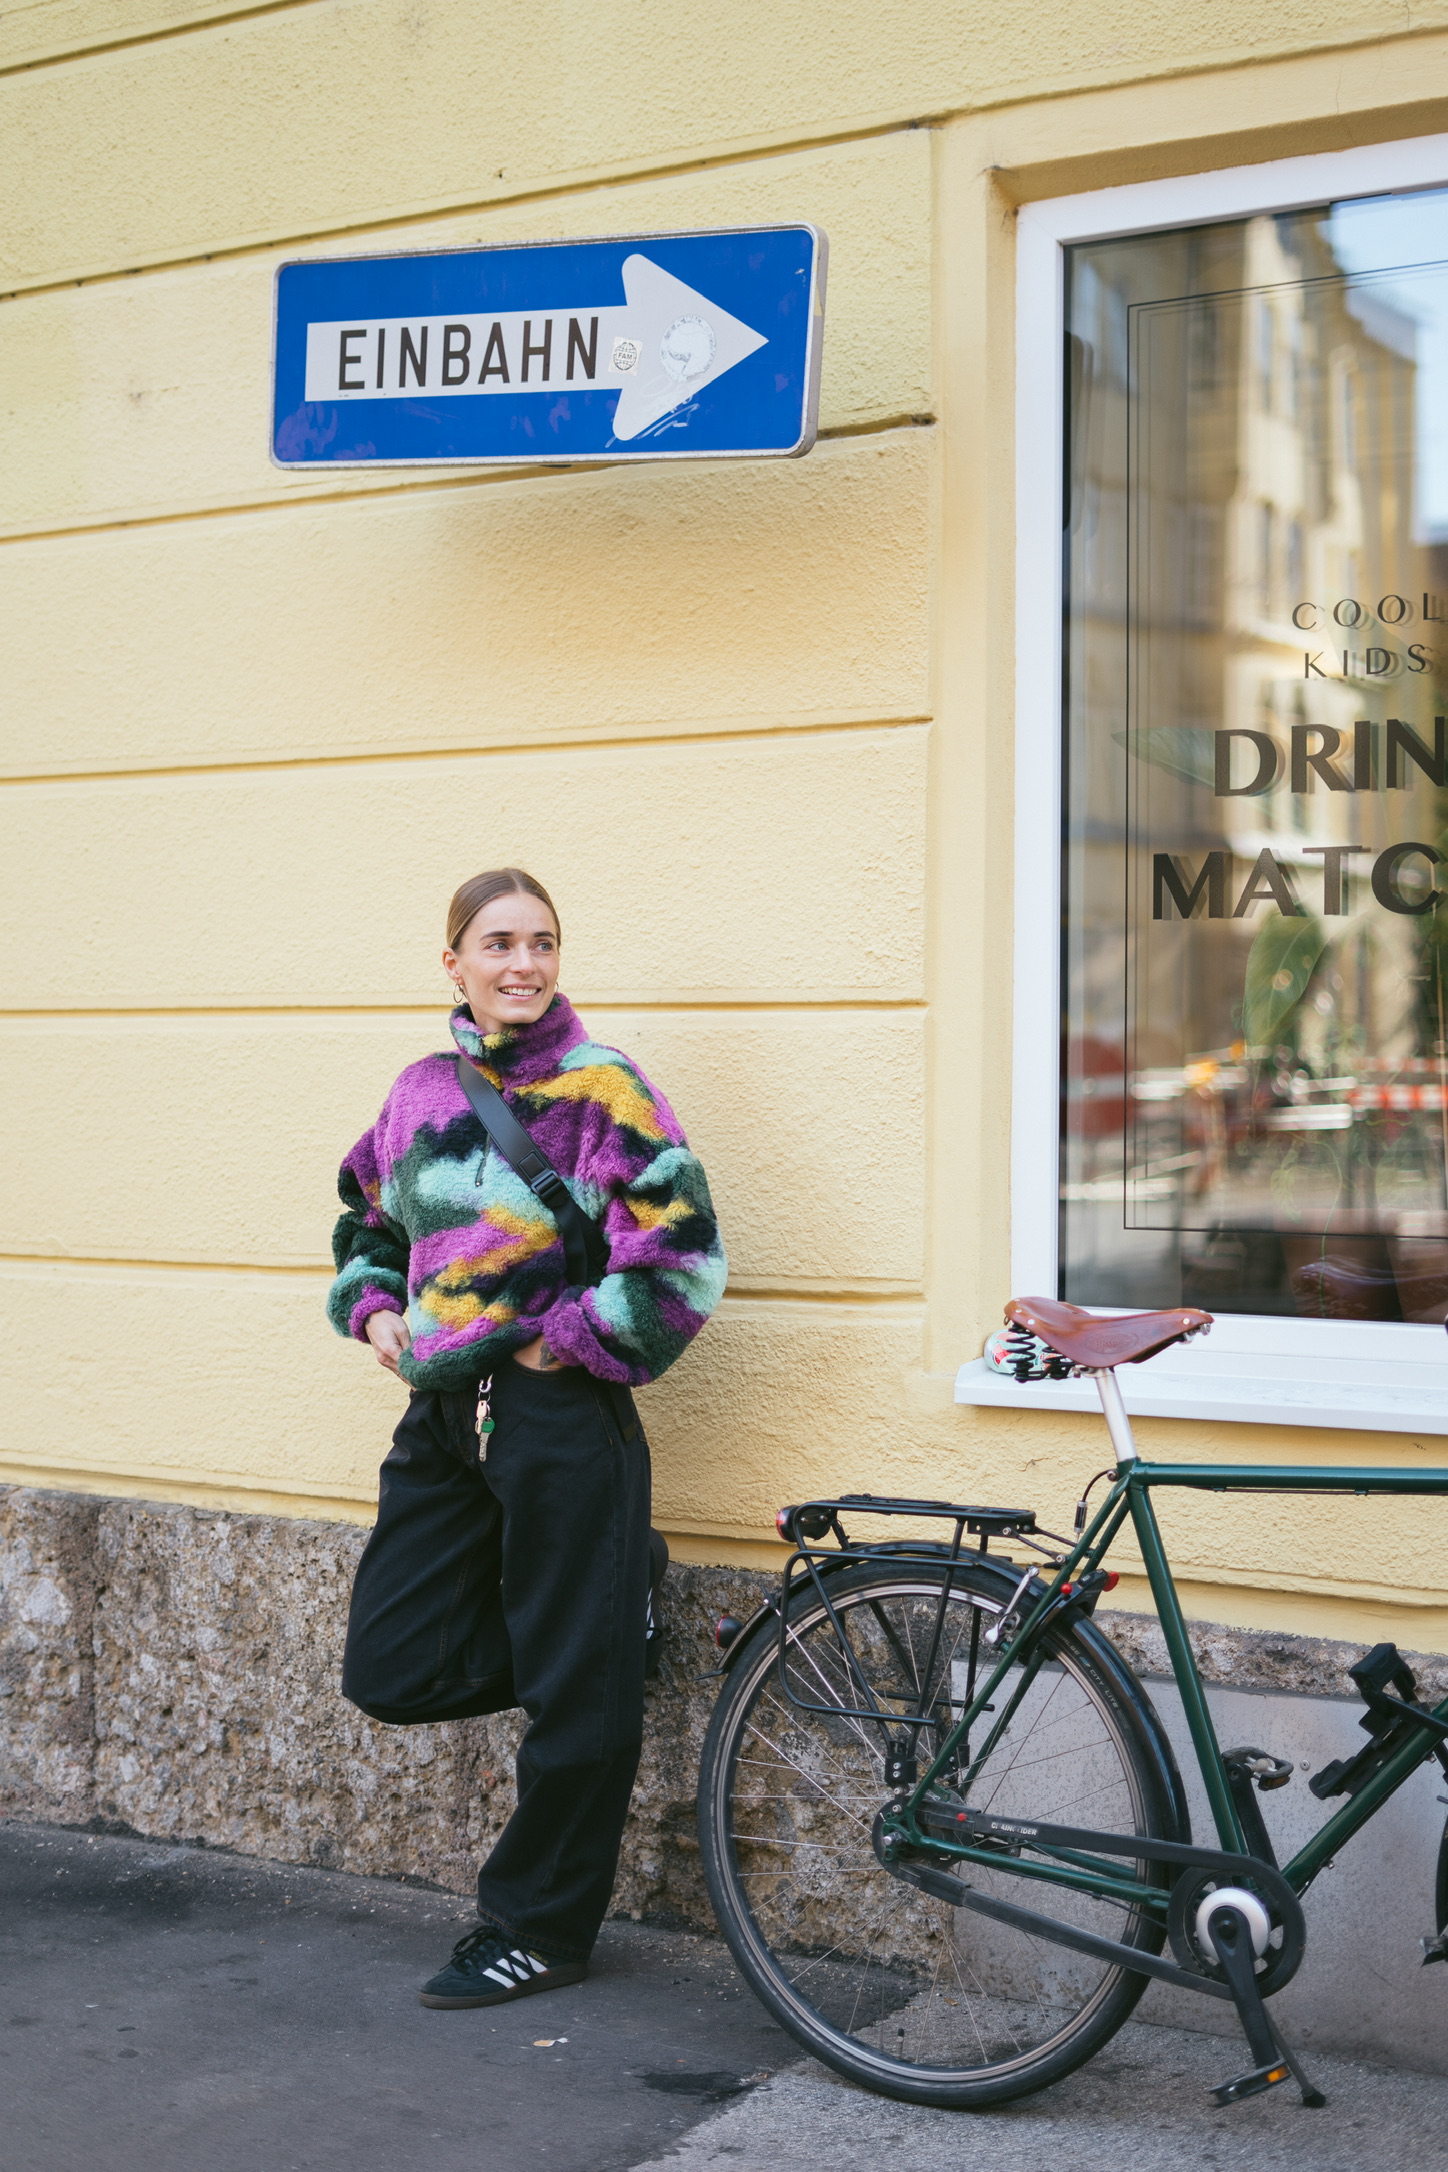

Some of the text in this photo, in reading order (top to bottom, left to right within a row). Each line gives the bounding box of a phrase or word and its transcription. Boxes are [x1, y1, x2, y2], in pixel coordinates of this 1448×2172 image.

[338, 316, 599, 391] EINBAHN
[617, 352, 633, 360] FAM
[1292, 592, 1441, 630] COOL
[1304, 643, 1427, 679] KIDS
[1214, 716, 1446, 797] DRIN
[1152, 841, 1441, 921] MATC
[1050, 1625, 1119, 1709] HWALBE CITY LITE
[991, 1821, 1038, 1836] CAINIDER
